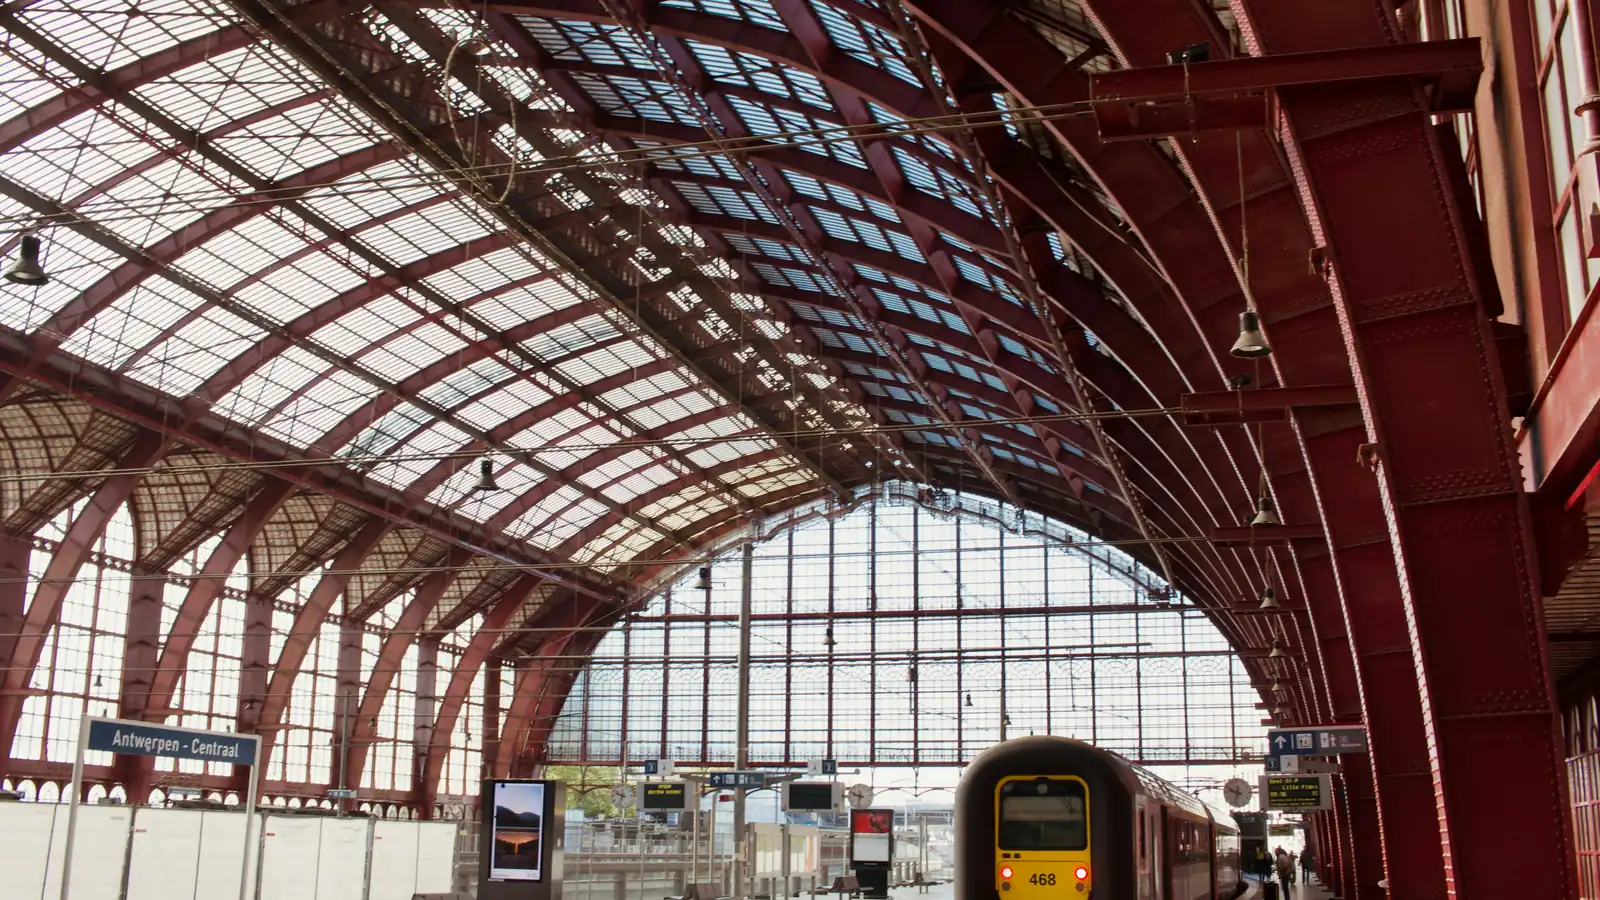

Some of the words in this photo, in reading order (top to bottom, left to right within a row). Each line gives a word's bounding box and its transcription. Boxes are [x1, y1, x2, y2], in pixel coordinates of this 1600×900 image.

[112, 730, 179, 754] Antwerpen
[191, 738, 239, 758] Centraal
[1029, 873, 1056, 886] 468
